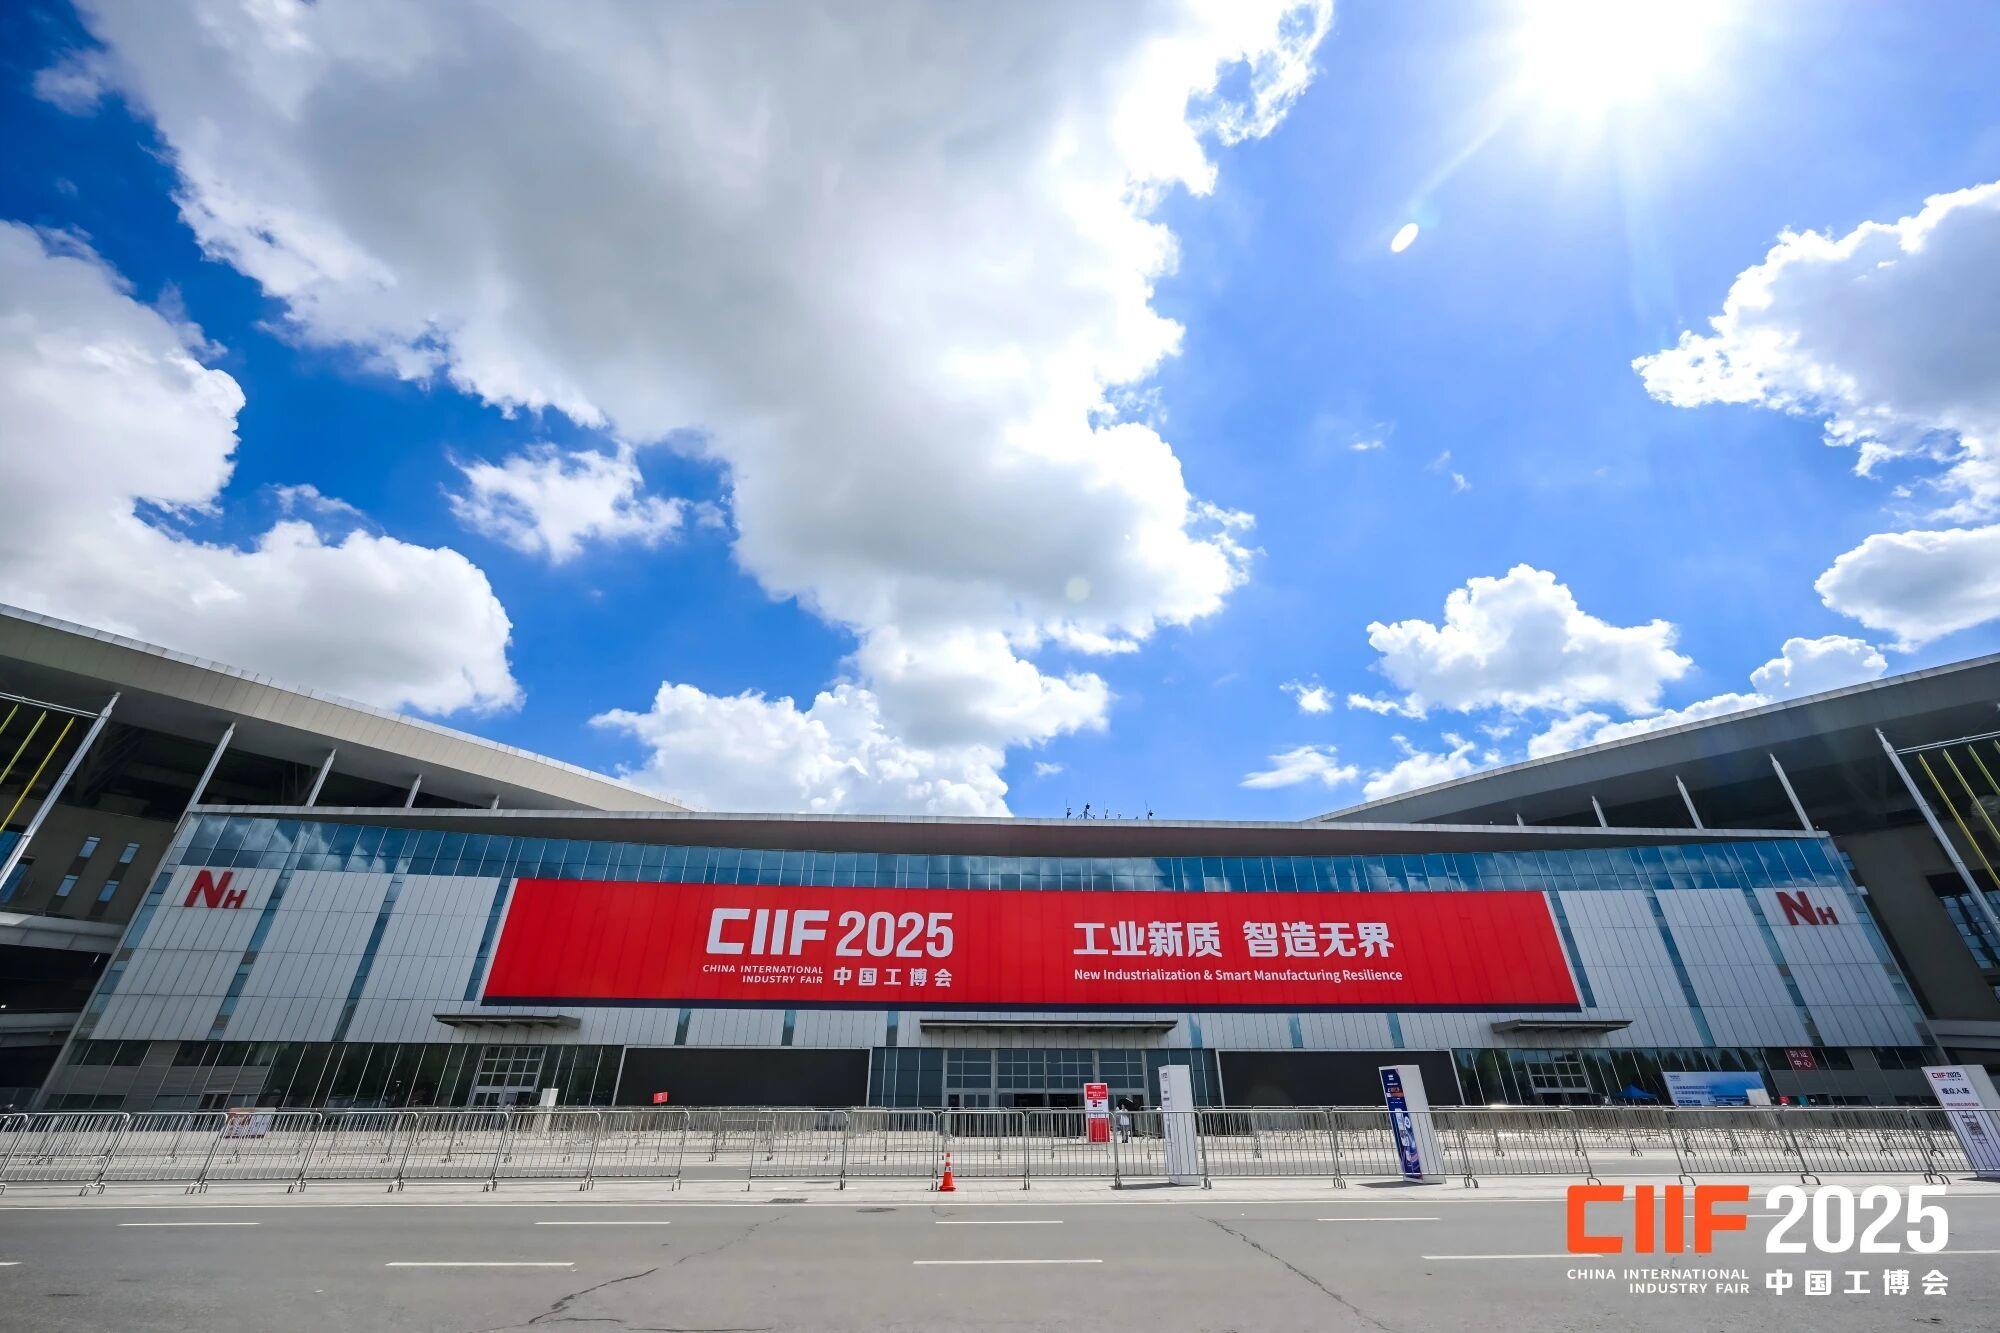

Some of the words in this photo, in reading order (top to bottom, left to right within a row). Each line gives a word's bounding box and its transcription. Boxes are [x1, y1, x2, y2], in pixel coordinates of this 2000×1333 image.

[706, 908, 830, 955] CIIF
[835, 910, 954, 958] 2025
[1073, 920, 1223, 958] 工业新质
[1242, 920, 1395, 958] 智造无界
[702, 964, 736, 974] CHINA
[740, 965, 824, 975] INTERNATIONAL
[833, 966, 953, 988] 中国工博会
[1074, 969, 1101, 980] New
[1103, 968, 1201, 981] Industrialization
[1203, 969, 1213, 981] &
[1215, 969, 1252, 981] Smart
[1253, 969, 1341, 984] Manufacturing
[1342, 969, 1403, 981] Resilience
[742, 975, 796, 984] INDUSTRY
[800, 975, 824, 984] FAIR
